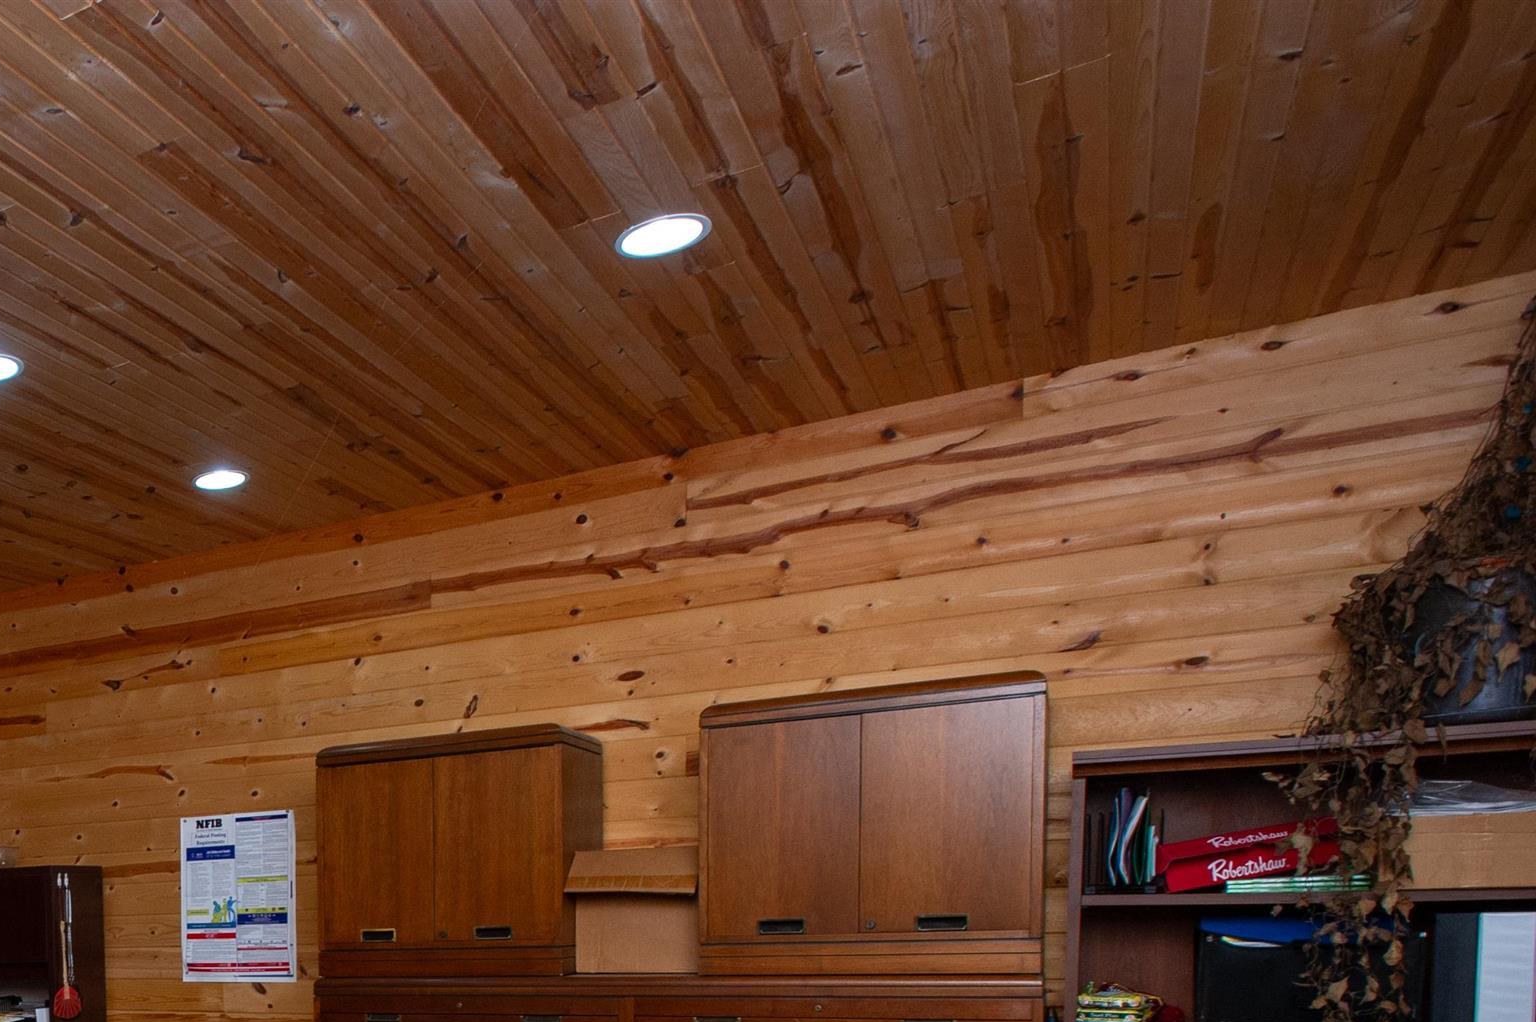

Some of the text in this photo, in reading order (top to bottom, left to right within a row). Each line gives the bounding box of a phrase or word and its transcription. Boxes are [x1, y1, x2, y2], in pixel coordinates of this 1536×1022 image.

[196, 818, 223, 829] NFIB
[1207, 831, 1289, 848] Robertshaw
[1208, 856, 1287, 881] Robertshaw
